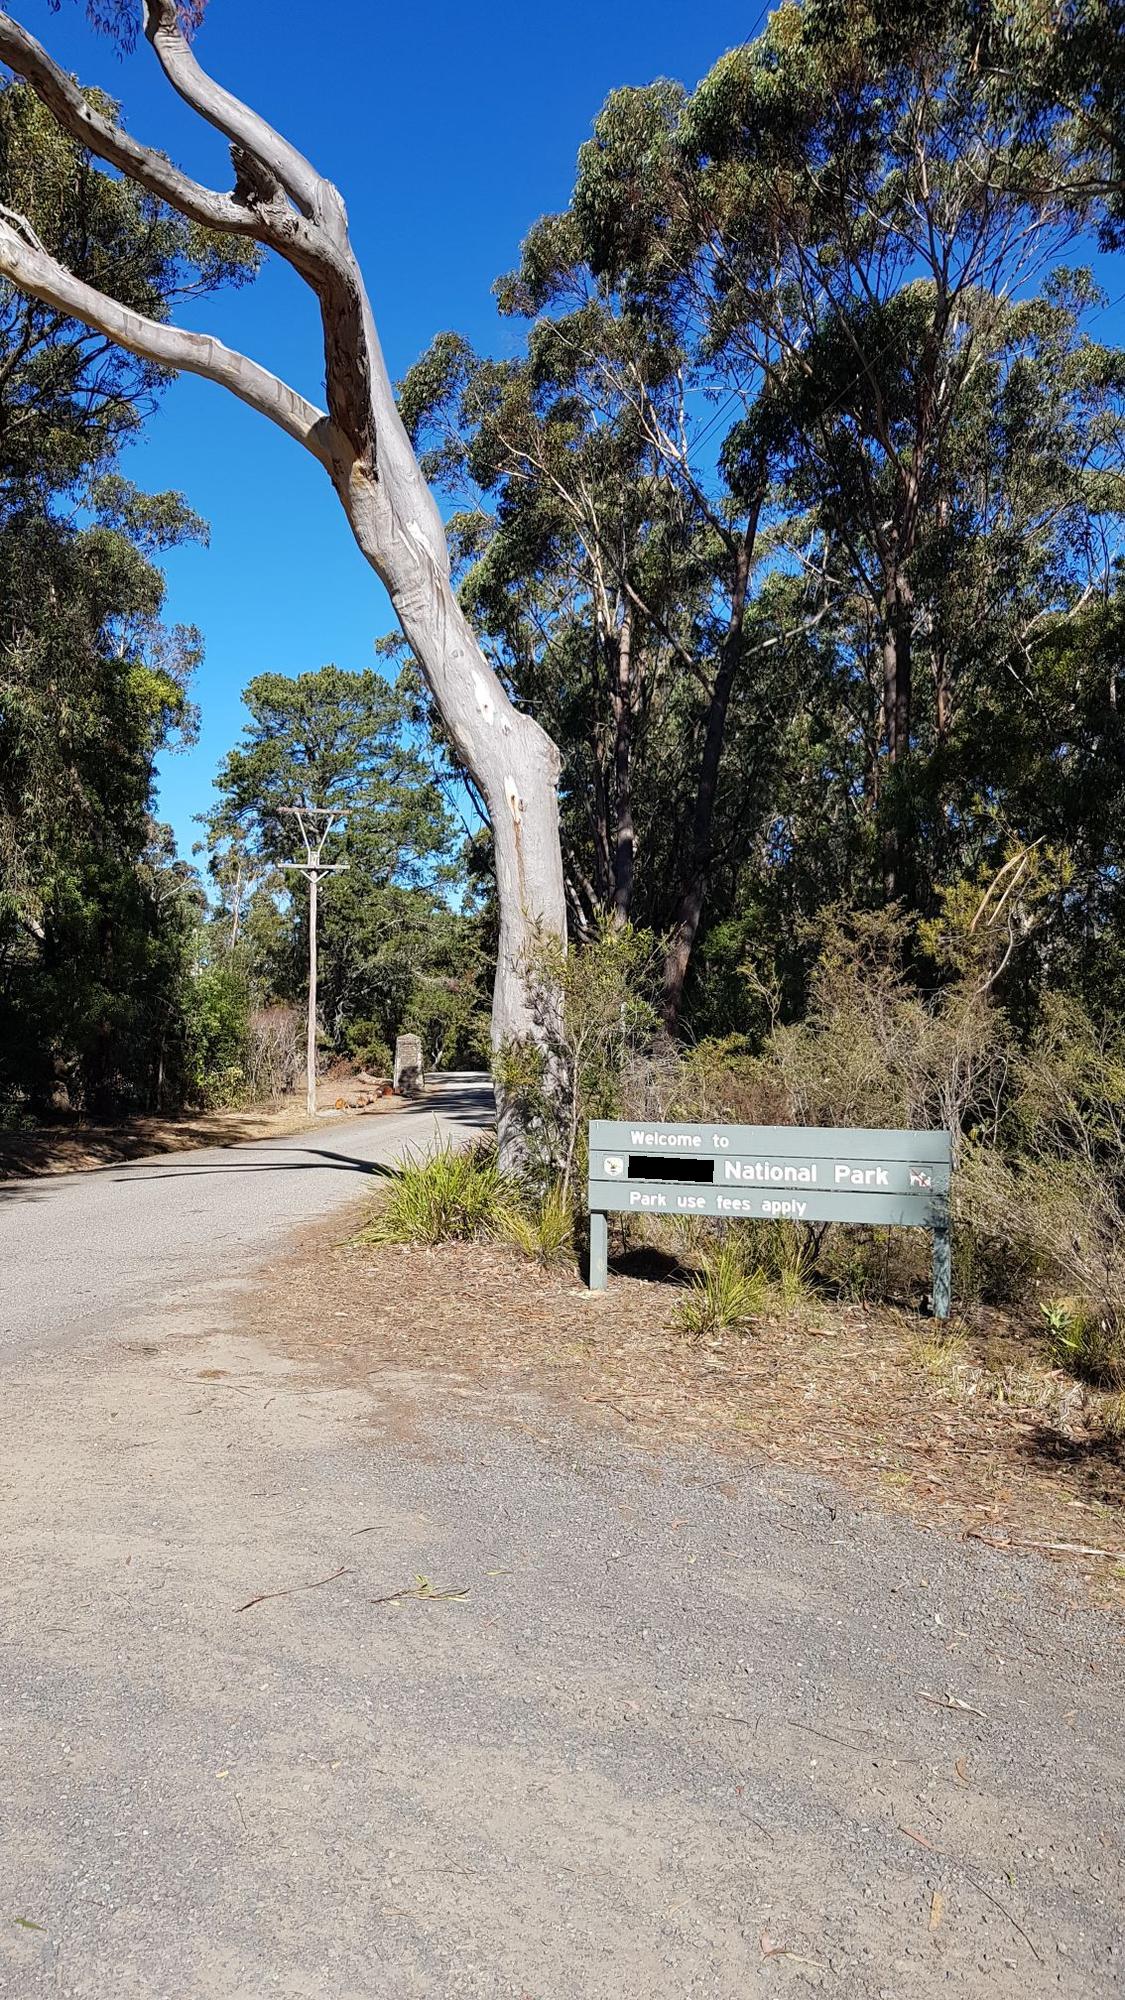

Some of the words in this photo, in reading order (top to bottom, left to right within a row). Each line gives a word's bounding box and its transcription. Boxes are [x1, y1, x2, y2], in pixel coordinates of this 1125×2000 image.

[630, 1130, 702, 1148] Welcome
[712, 1133, 730, 1149] to
[724, 1160, 818, 1183] National
[834, 1164, 889, 1186] Park
[629, 1191, 667, 1208] Park
[677, 1196, 706, 1210] use
[716, 1194, 752, 1212] fees
[761, 1197, 808, 1217] apply
